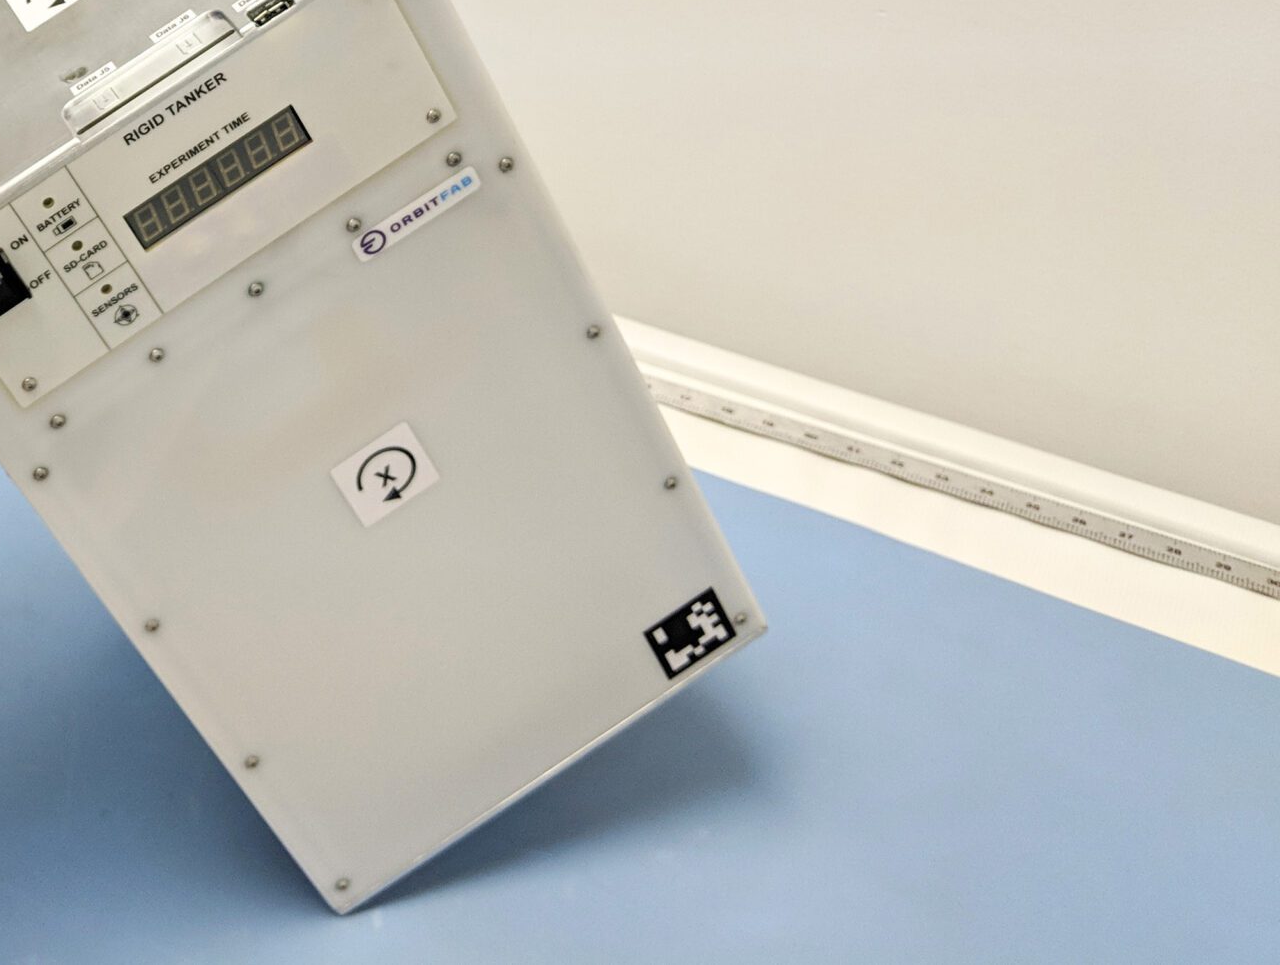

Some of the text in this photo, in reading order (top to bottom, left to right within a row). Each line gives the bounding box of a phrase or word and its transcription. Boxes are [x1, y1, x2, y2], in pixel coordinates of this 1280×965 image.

[155, 22, 177, 38] Data
[76, 75, 98, 91] Data
[122, 72, 228, 145] RIGID TANKER
[148, 111, 252, 184] EXPERIMENT TIME
[36, 198, 81, 232] BATTERY
[390, 176, 472, 233] ORBITFAB
[10, 234, 29, 250] ON
[63, 240, 108, 273] SD-CARD
[30, 269, 51, 289] OFF
[91, 283, 138, 317] SENSORS
[374, 464, 397, 489] X
